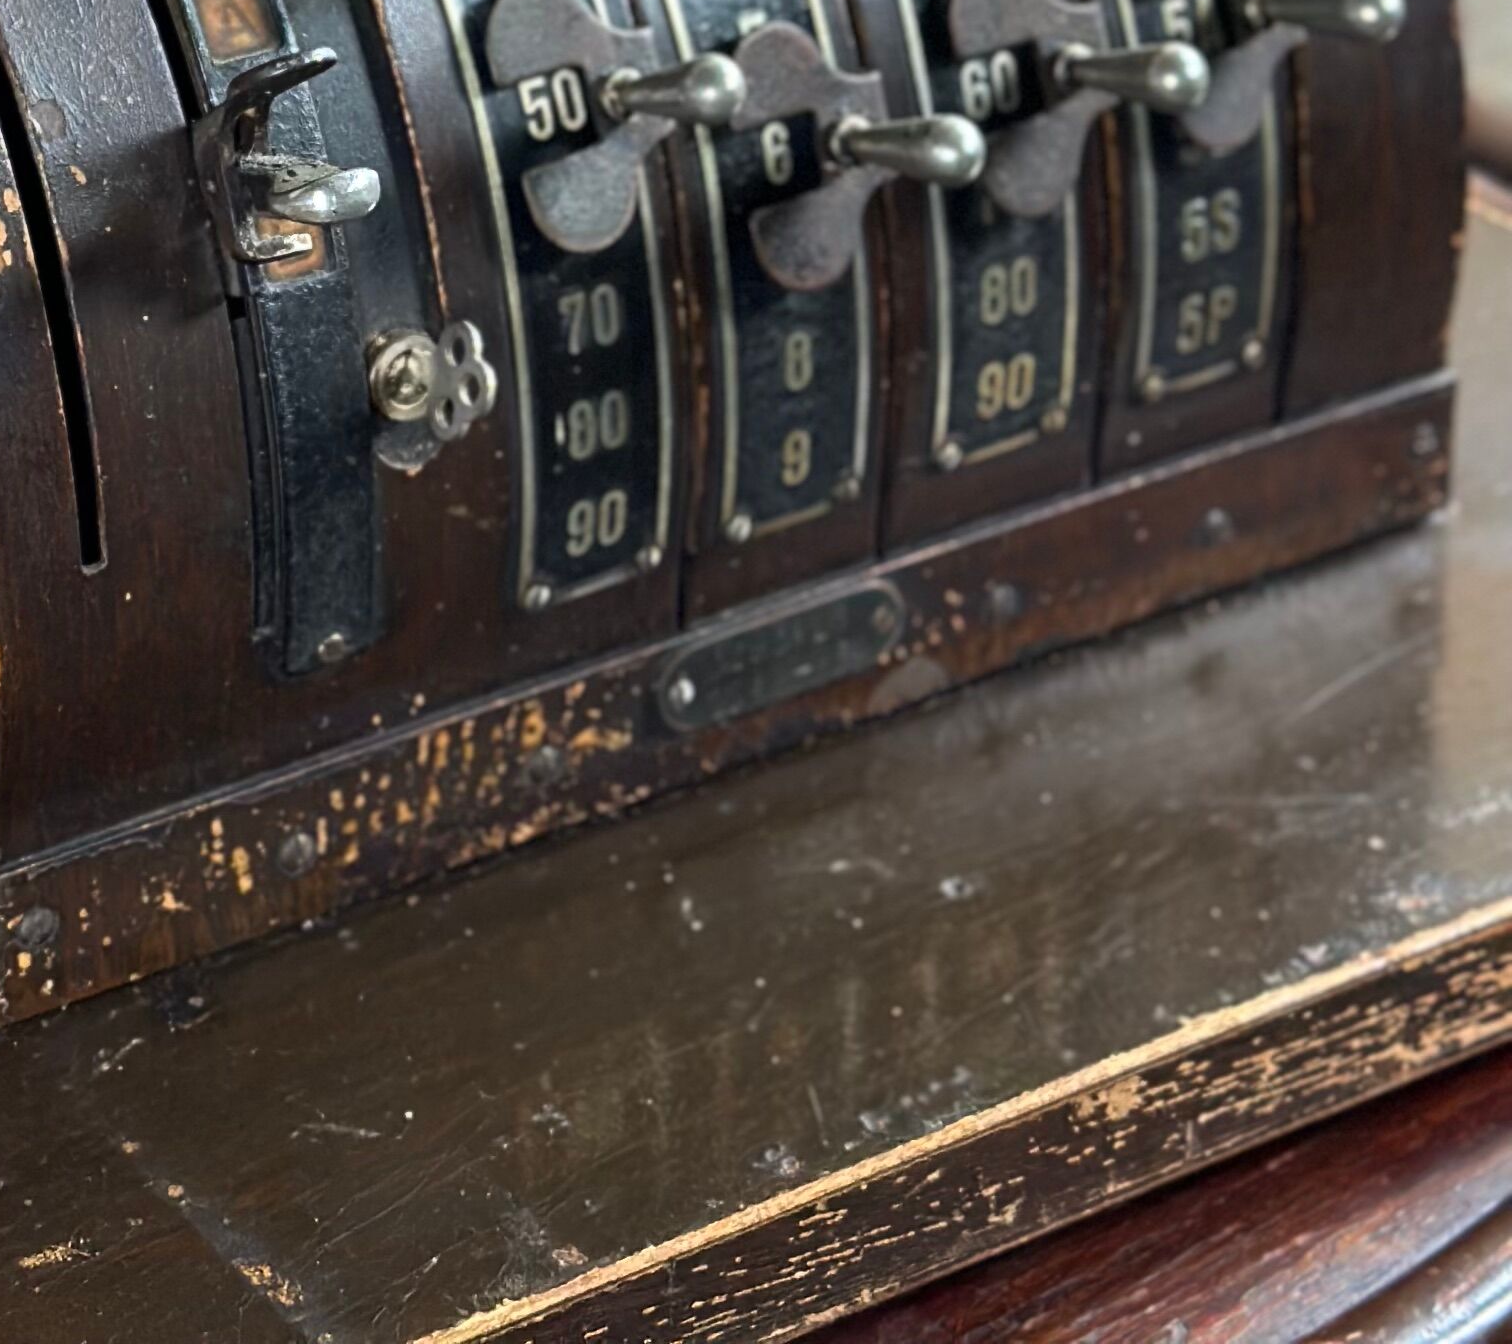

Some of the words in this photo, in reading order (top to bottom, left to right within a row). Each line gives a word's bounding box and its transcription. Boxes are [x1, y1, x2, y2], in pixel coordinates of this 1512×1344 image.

[517, 68, 586, 142] 50
[959, 48, 1021, 122] 60
[760, 120, 794, 185] 6
[556, 281, 622, 356] 70
[979, 256, 1038, 326] 80
[783, 330, 813, 391] 8
[976, 351, 1037, 420] 90
[567, 389, 629, 461] 80
[781, 428, 812, 487] 9
[564, 488, 629, 557] 90
